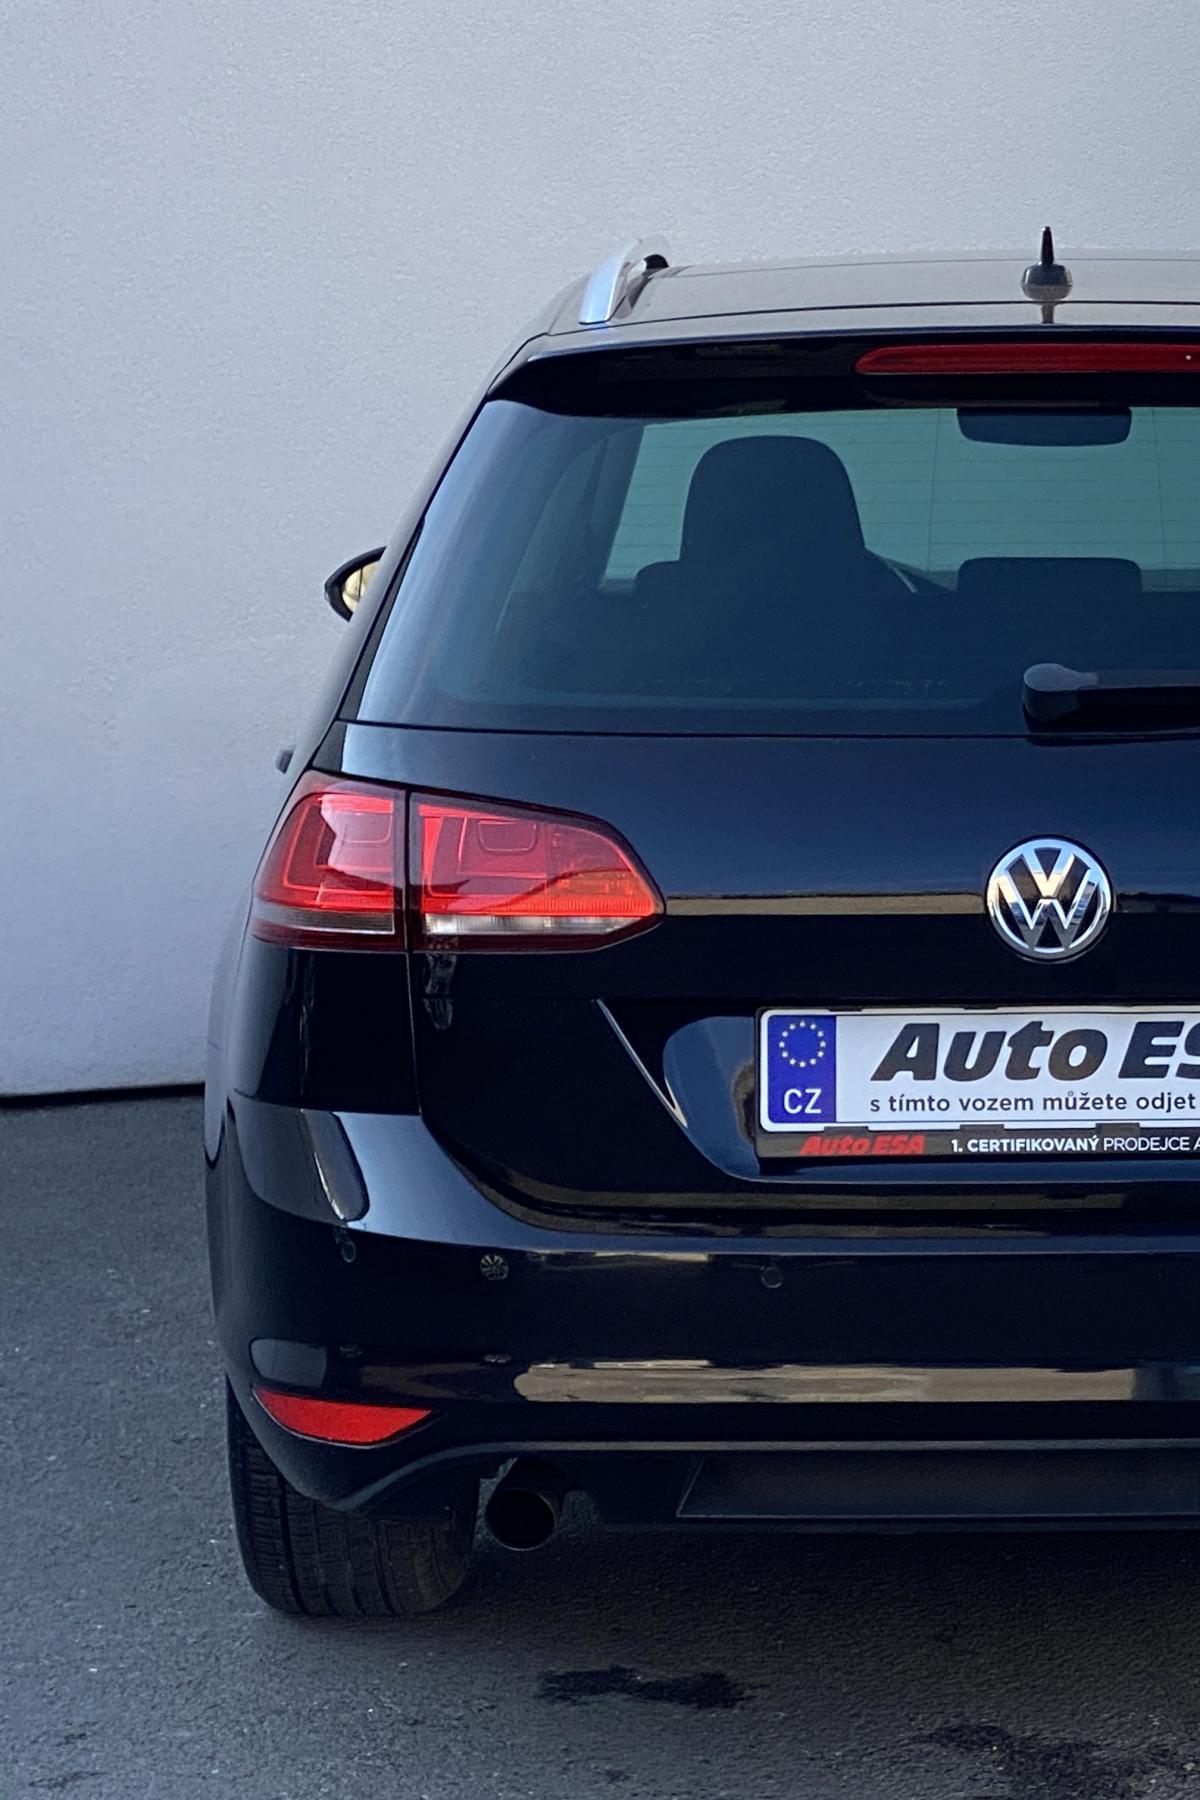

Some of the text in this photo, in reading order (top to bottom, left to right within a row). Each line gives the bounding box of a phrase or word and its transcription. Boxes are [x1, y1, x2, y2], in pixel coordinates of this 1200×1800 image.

[870, 1021, 1108, 1082] Auto
[783, 1088, 822, 1114] CZ
[870, 1099, 880, 1112] s
[889, 1094, 949, 1112] tímto
[959, 1098, 1034, 1112] vozem
[1043, 1091, 1127, 1111] můžete
[1136, 1092, 1196, 1113] odjet
[871, 1135, 926, 1155] ESA
[951, 1139, 963, 1153] 1.
[967, 1135, 1099, 1153] CERTIFIKOVANÝ
[1103, 1137, 1190, 1151] PRODEJCE
